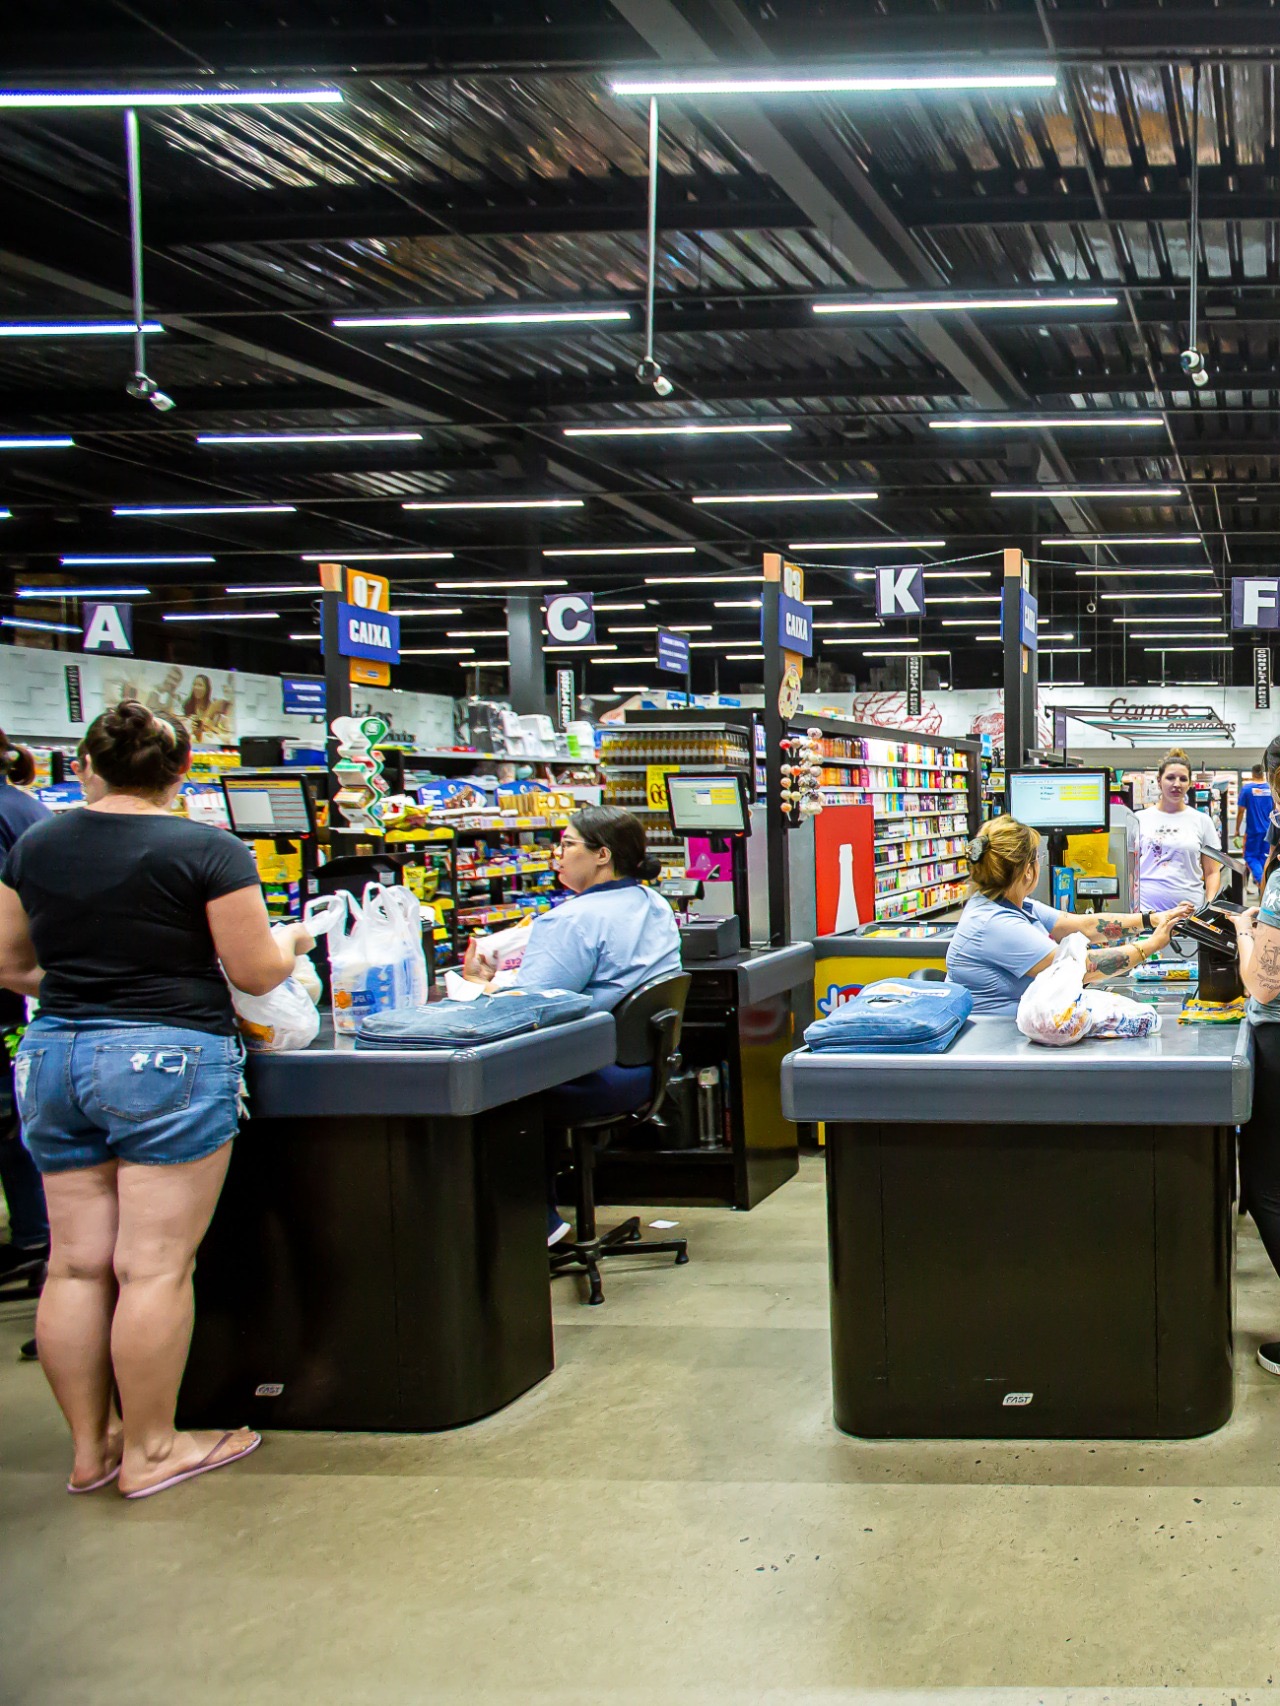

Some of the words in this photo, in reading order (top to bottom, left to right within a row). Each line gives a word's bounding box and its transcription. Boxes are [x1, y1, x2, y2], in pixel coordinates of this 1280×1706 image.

[352, 575, 383, 611] 07
[879, 567, 921, 614] K
[1243, 580, 1279, 626] F
[83, 605, 132, 650] A
[348, 618, 392, 649] CAIXA
[547, 596, 592, 642] C
[785, 612, 808, 642] CAIXA
[1108, 697, 1190, 721] Carnes
